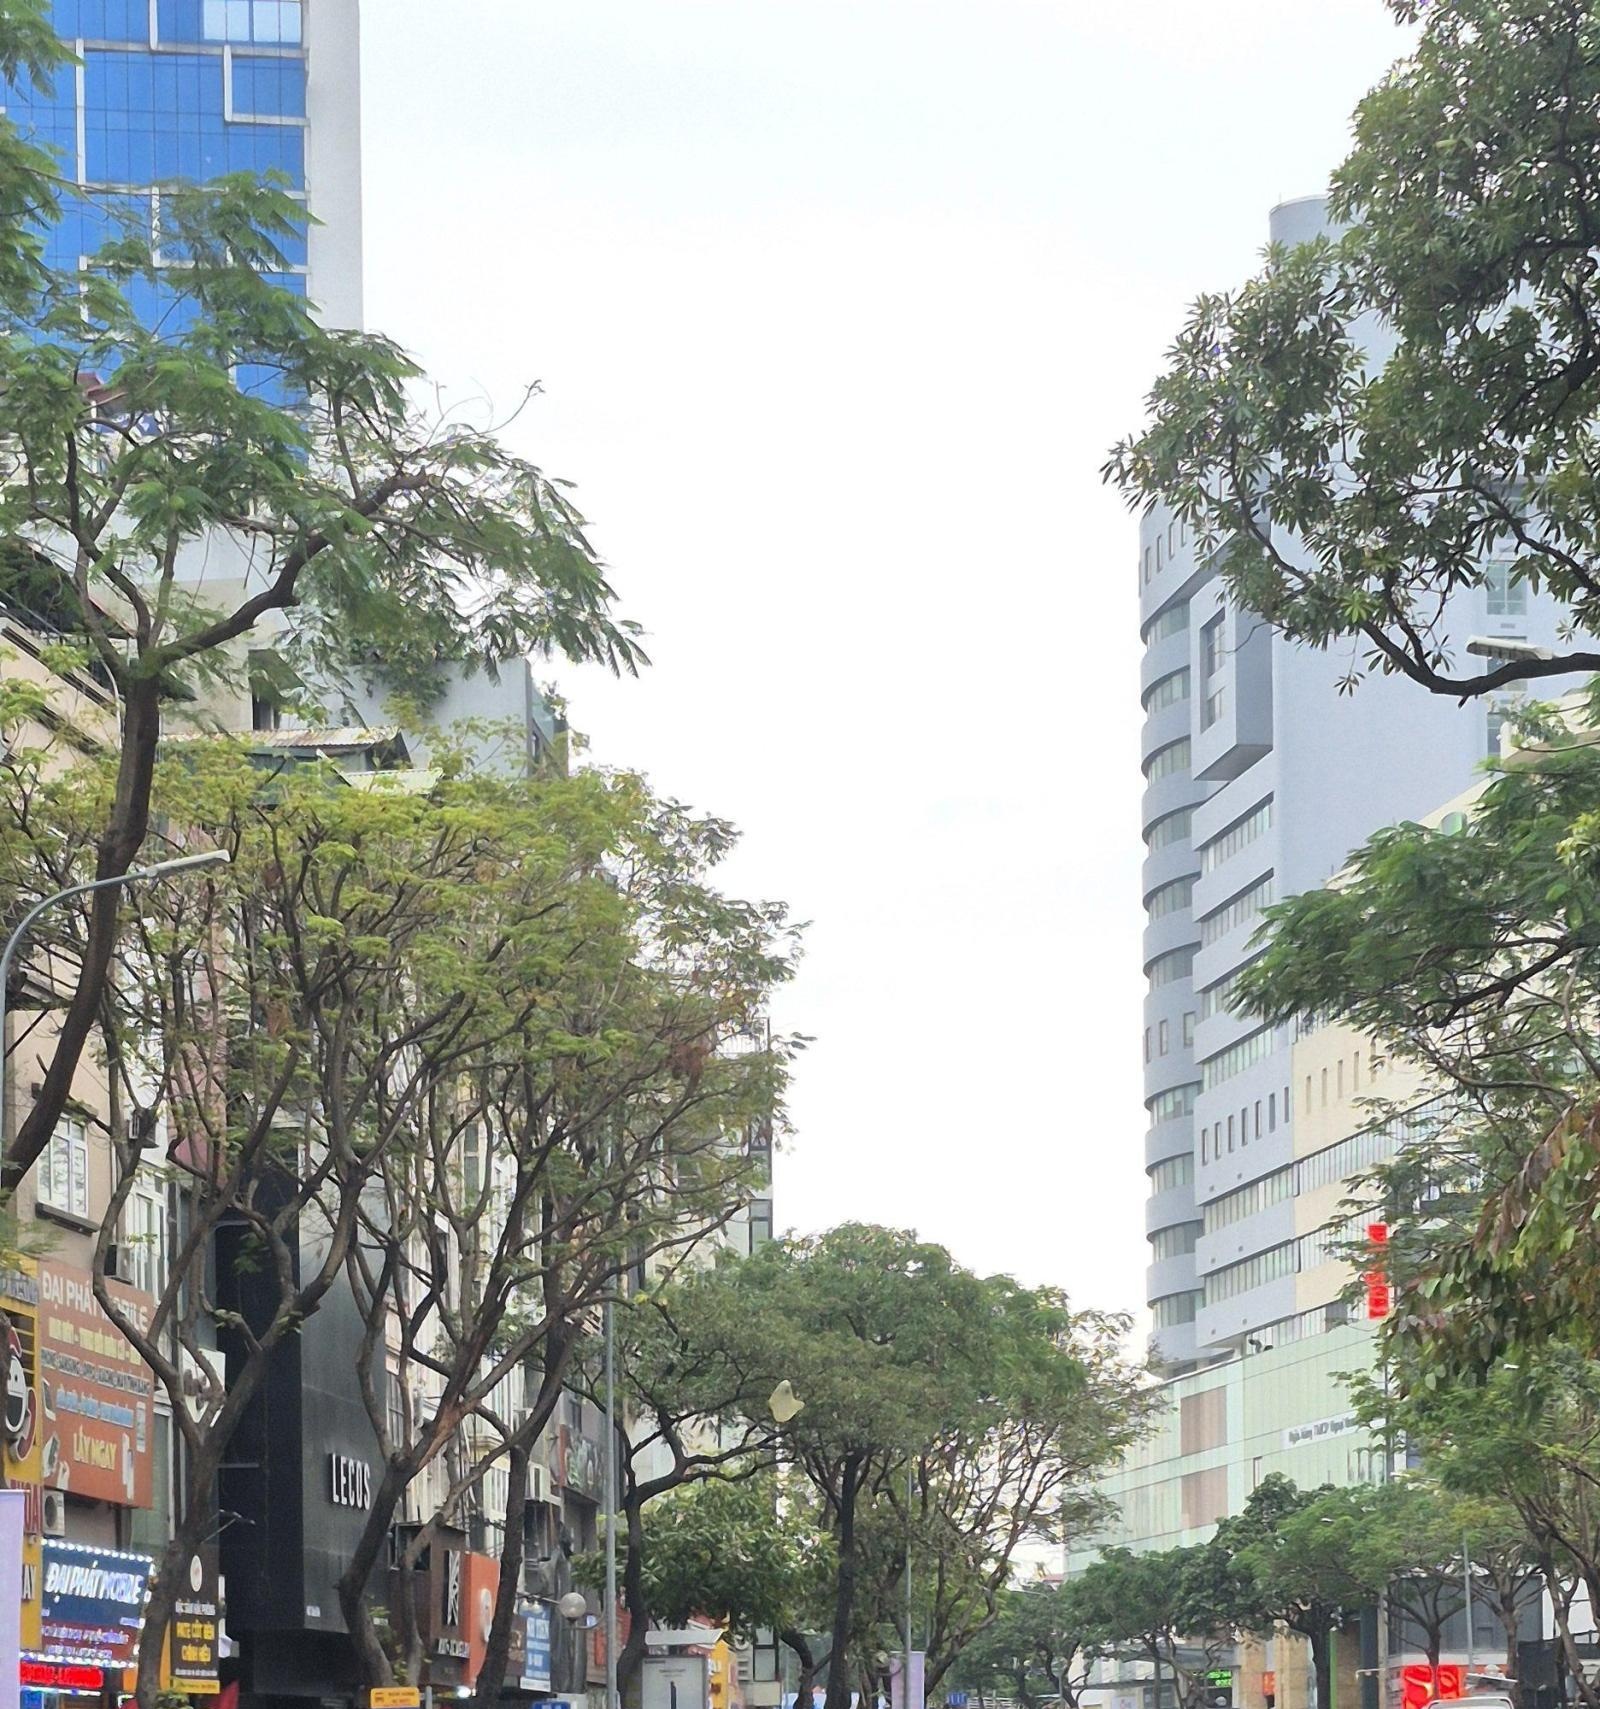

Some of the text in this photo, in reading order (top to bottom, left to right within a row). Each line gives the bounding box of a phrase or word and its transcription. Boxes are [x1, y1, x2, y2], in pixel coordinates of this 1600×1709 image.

[42, 1270, 64, 1310] ĐẠI
[332, 1452, 370, 1511] LECOS
[44, 1562, 71, 1603] ĐẠI
[67, 1560, 103, 1599] PHÁT
